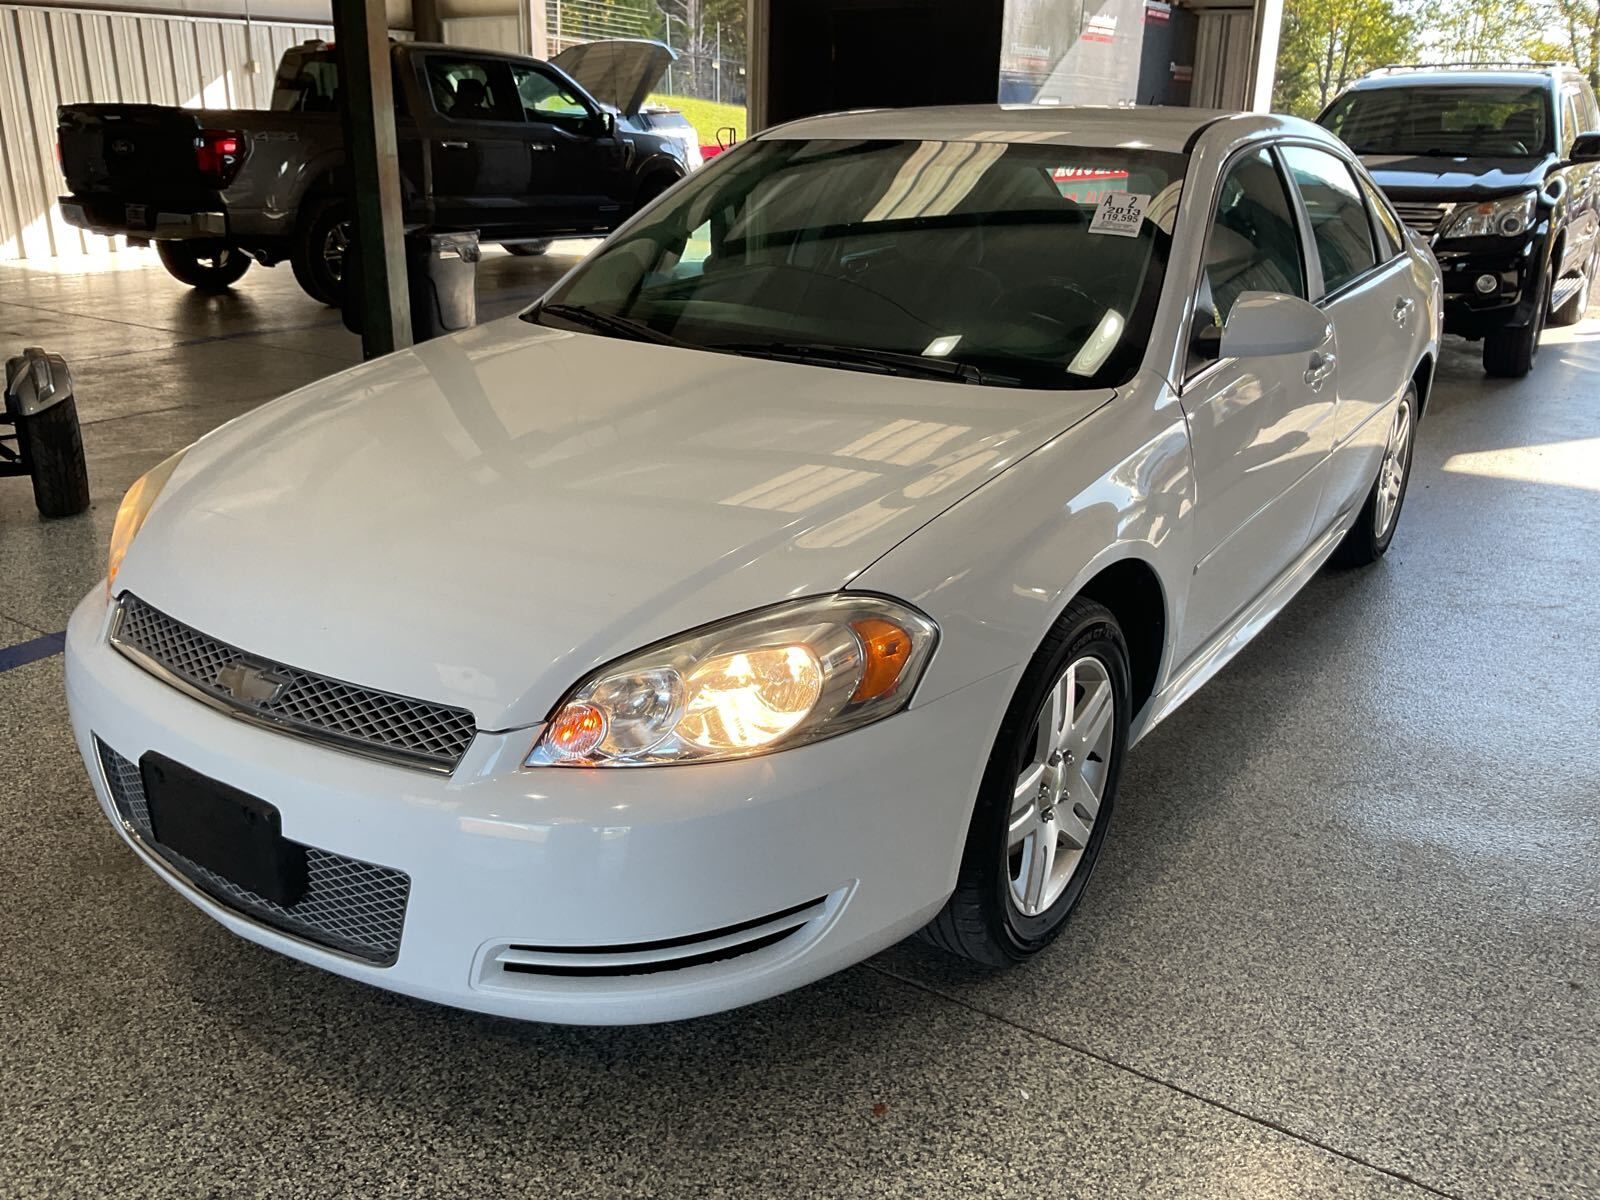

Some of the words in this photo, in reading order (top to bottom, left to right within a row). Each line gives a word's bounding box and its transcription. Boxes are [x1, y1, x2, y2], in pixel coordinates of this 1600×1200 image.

[1104, 195, 1113, 207] A
[1129, 197, 1138, 208] 2
[1107, 207, 1140, 216] 2013
